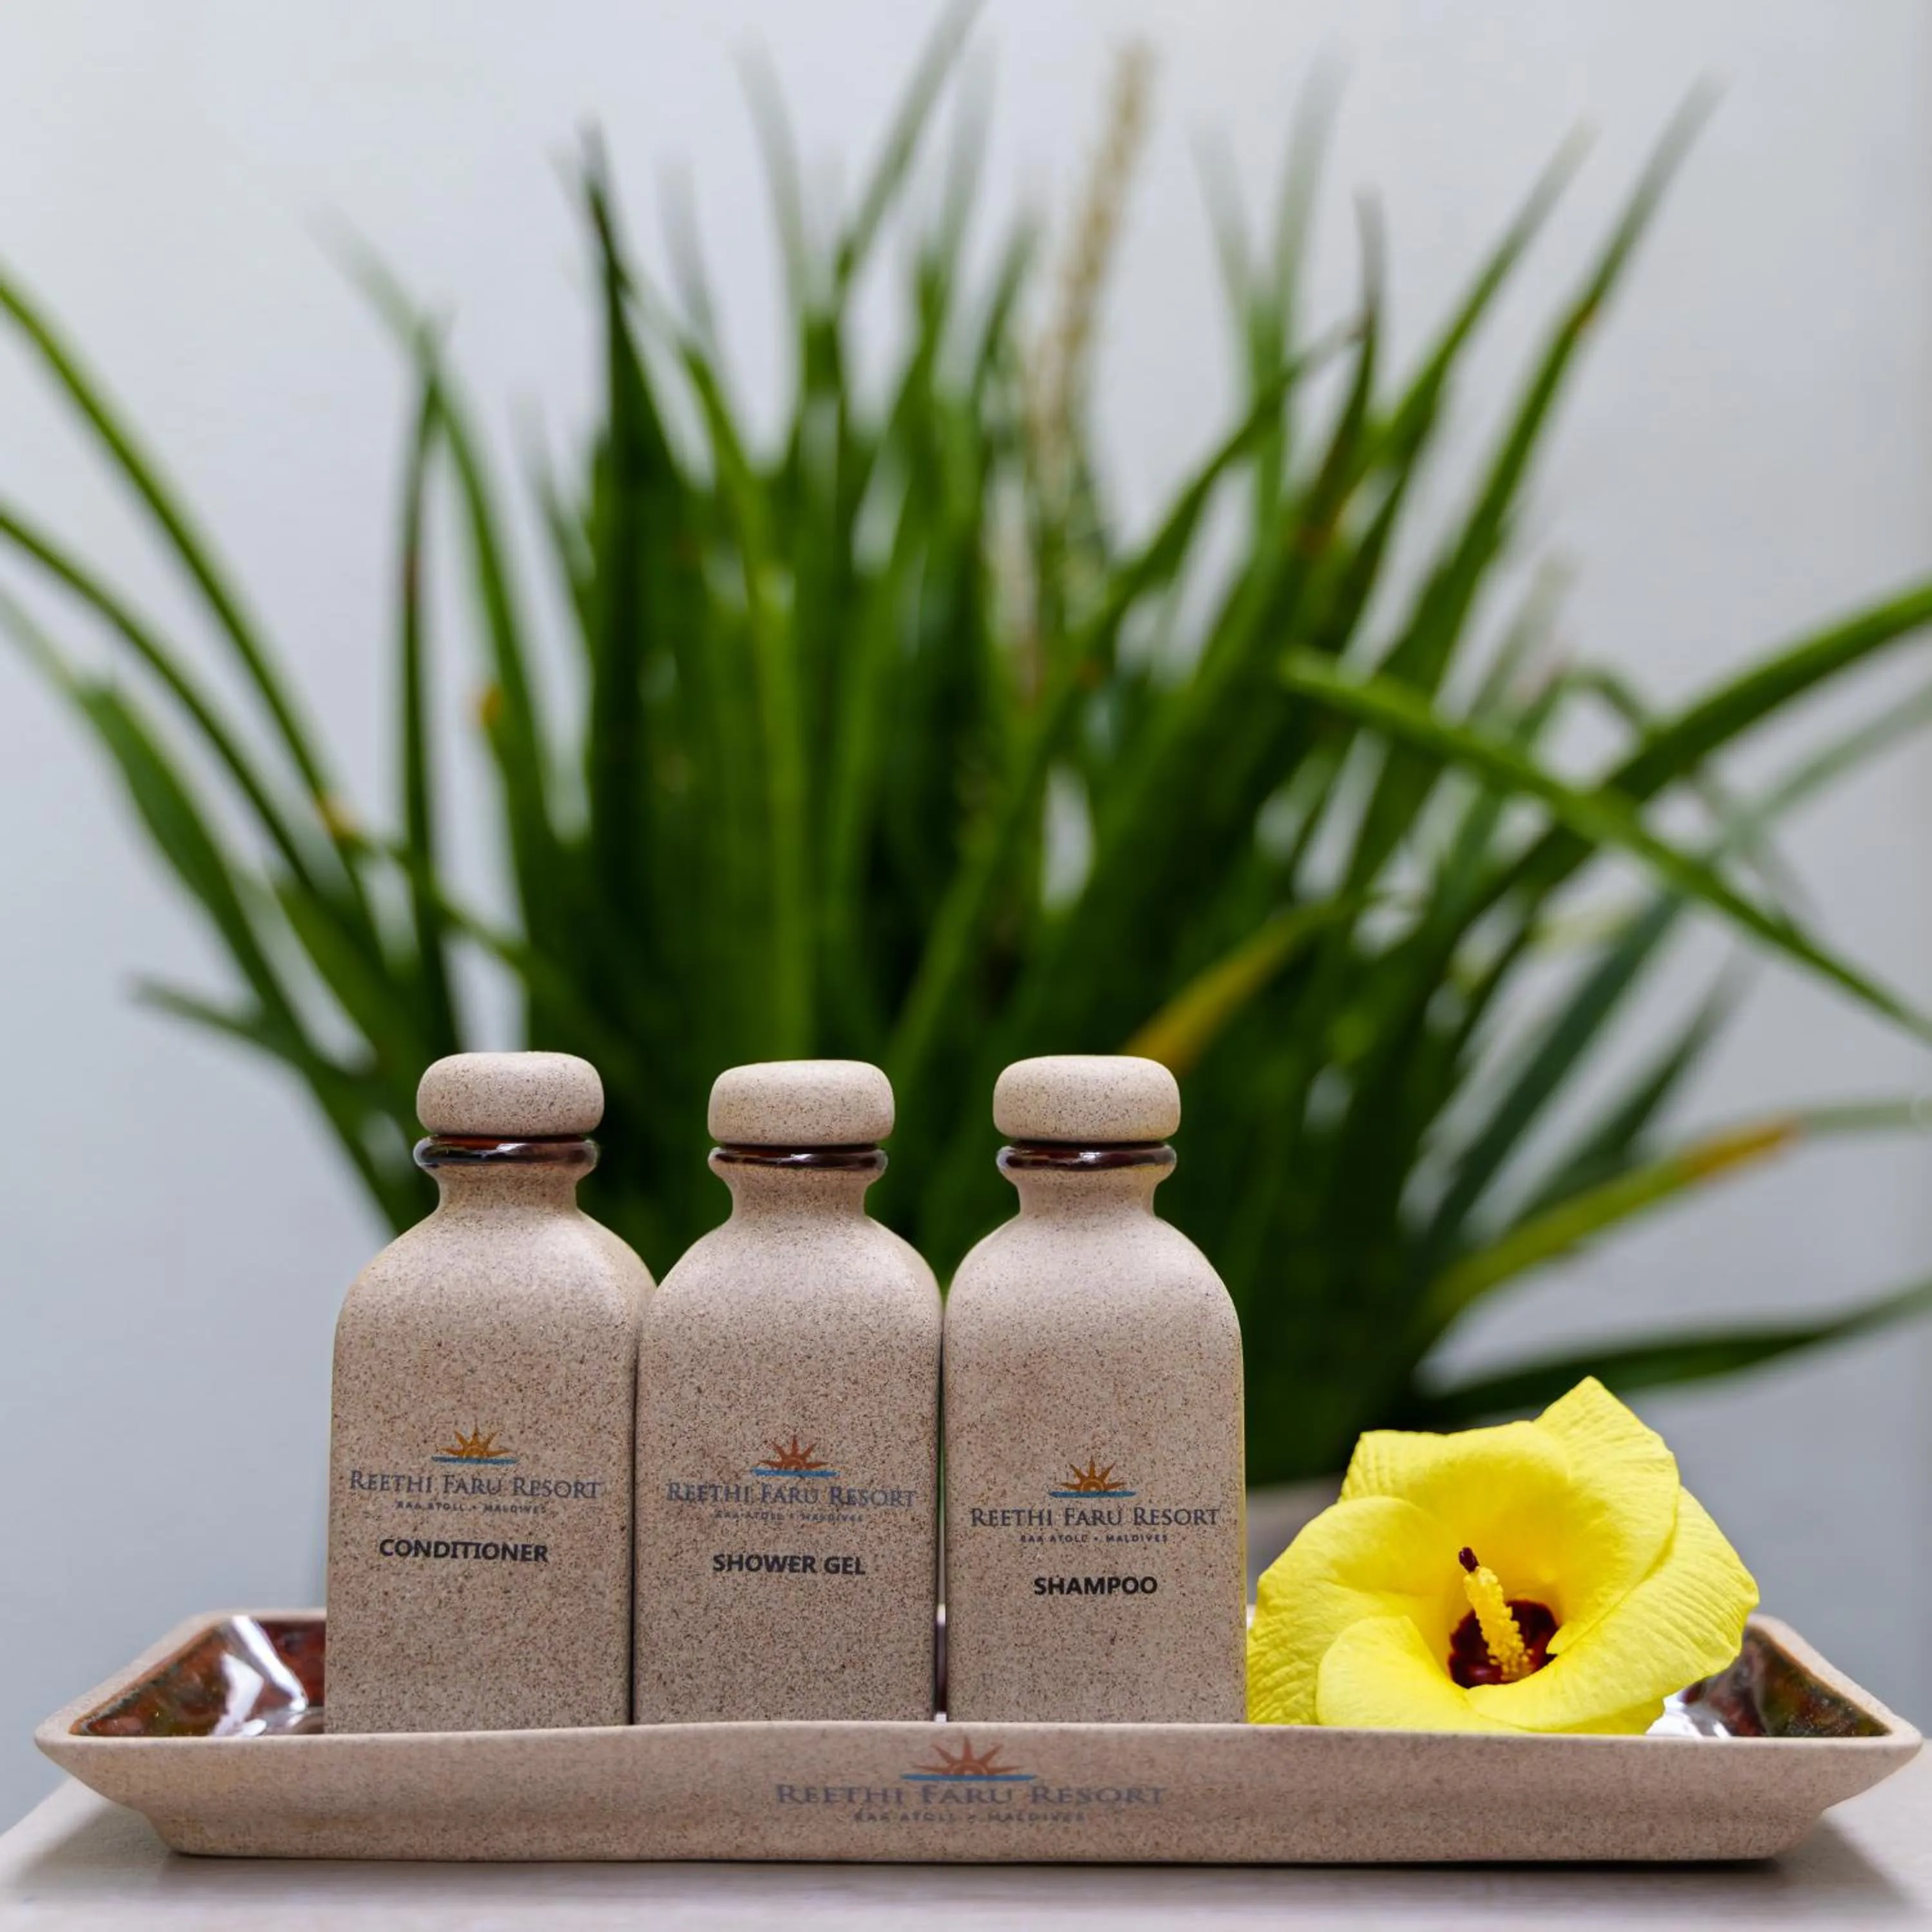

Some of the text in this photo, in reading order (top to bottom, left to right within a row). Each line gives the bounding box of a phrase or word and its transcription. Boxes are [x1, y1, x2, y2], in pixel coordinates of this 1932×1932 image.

[350, 1470, 602, 1499] REETHI FARU RESORT
[666, 1482, 916, 1507] REETHI FARU RESORT
[970, 1507, 1221, 1527] REETHI FARU RESORT
[379, 1539, 549, 1562] CONDITIONER
[713, 1553, 866, 1575] SHOWER GEL
[1034, 1576, 1158, 1595] SHAMPOO
[775, 1783, 1168, 1806] REETHI FARU RESORT
